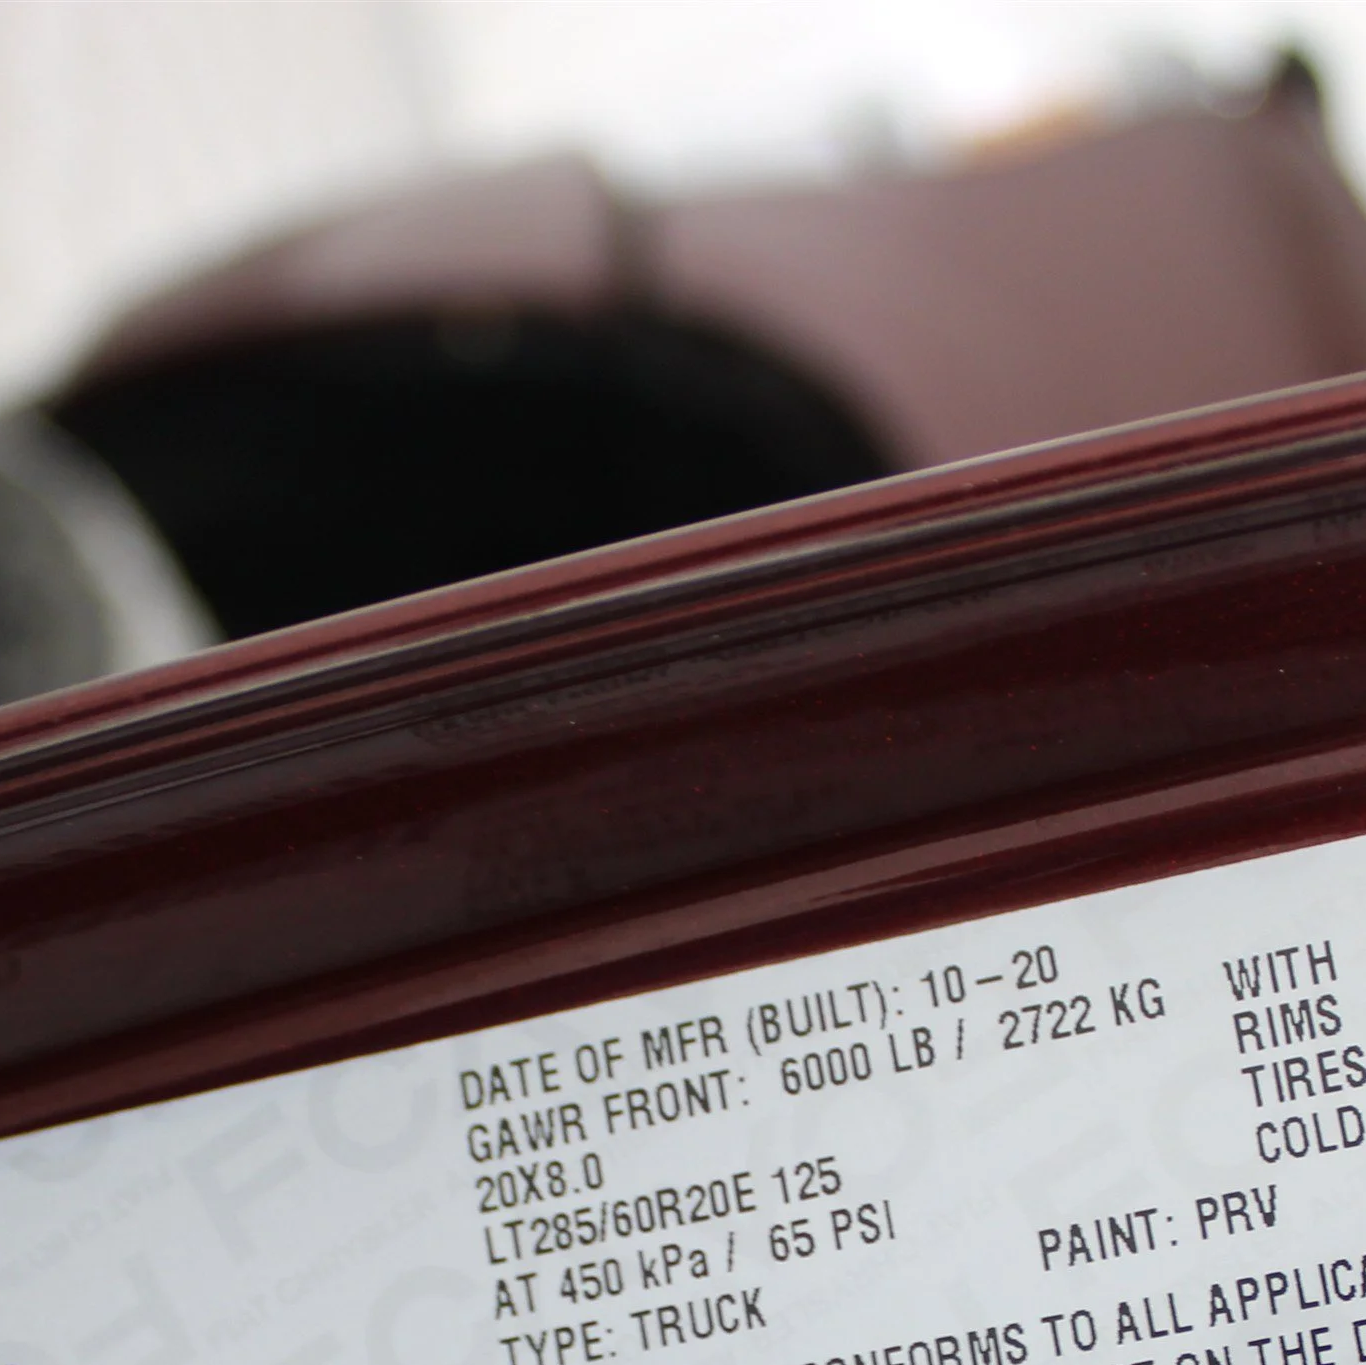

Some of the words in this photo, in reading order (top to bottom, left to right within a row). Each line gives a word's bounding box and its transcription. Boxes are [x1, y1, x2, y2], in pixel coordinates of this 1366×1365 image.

[1222, 940, 1337, 1001] WITH
[459, 1052, 561, 1111] DATE
[575, 1037, 623, 1084] OF
[641, 1016, 728, 1070] MFR
[747, 981, 903, 1056] (BUILT):
[1233, 994, 1342, 1054] RIMS
[467, 1103, 587, 1163] GAWR
[603, 1069, 748, 1134] FRONT:
[781, 1043, 872, 1095] 6000
[888, 1027, 935, 1073] LB
[999, 995, 1096, 1050] 2722
[1110, 978, 1165, 1026] KG
[1256, 1105, 1365, 1163] COLD
[476, 1153, 603, 1213] 20X8.0
[485, 1171, 756, 1265] LT285/60R20E
[771, 1156, 842, 1204] 125
[1038, 1208, 1177, 1271] PAINT:
[1195, 1184, 1276, 1240] PRV
[496, 1272, 537, 1319] AT
[560, 1259, 624, 1303] 450
[638, 1244, 709, 1289] kPa
[769, 1219, 816, 1262] 65
[830, 1200, 895, 1250] PSI
[629, 1288, 766, 1350] TRUCK
[1041, 1310, 1097, 1356] TO
[1117, 1293, 1193, 1345] ALL
